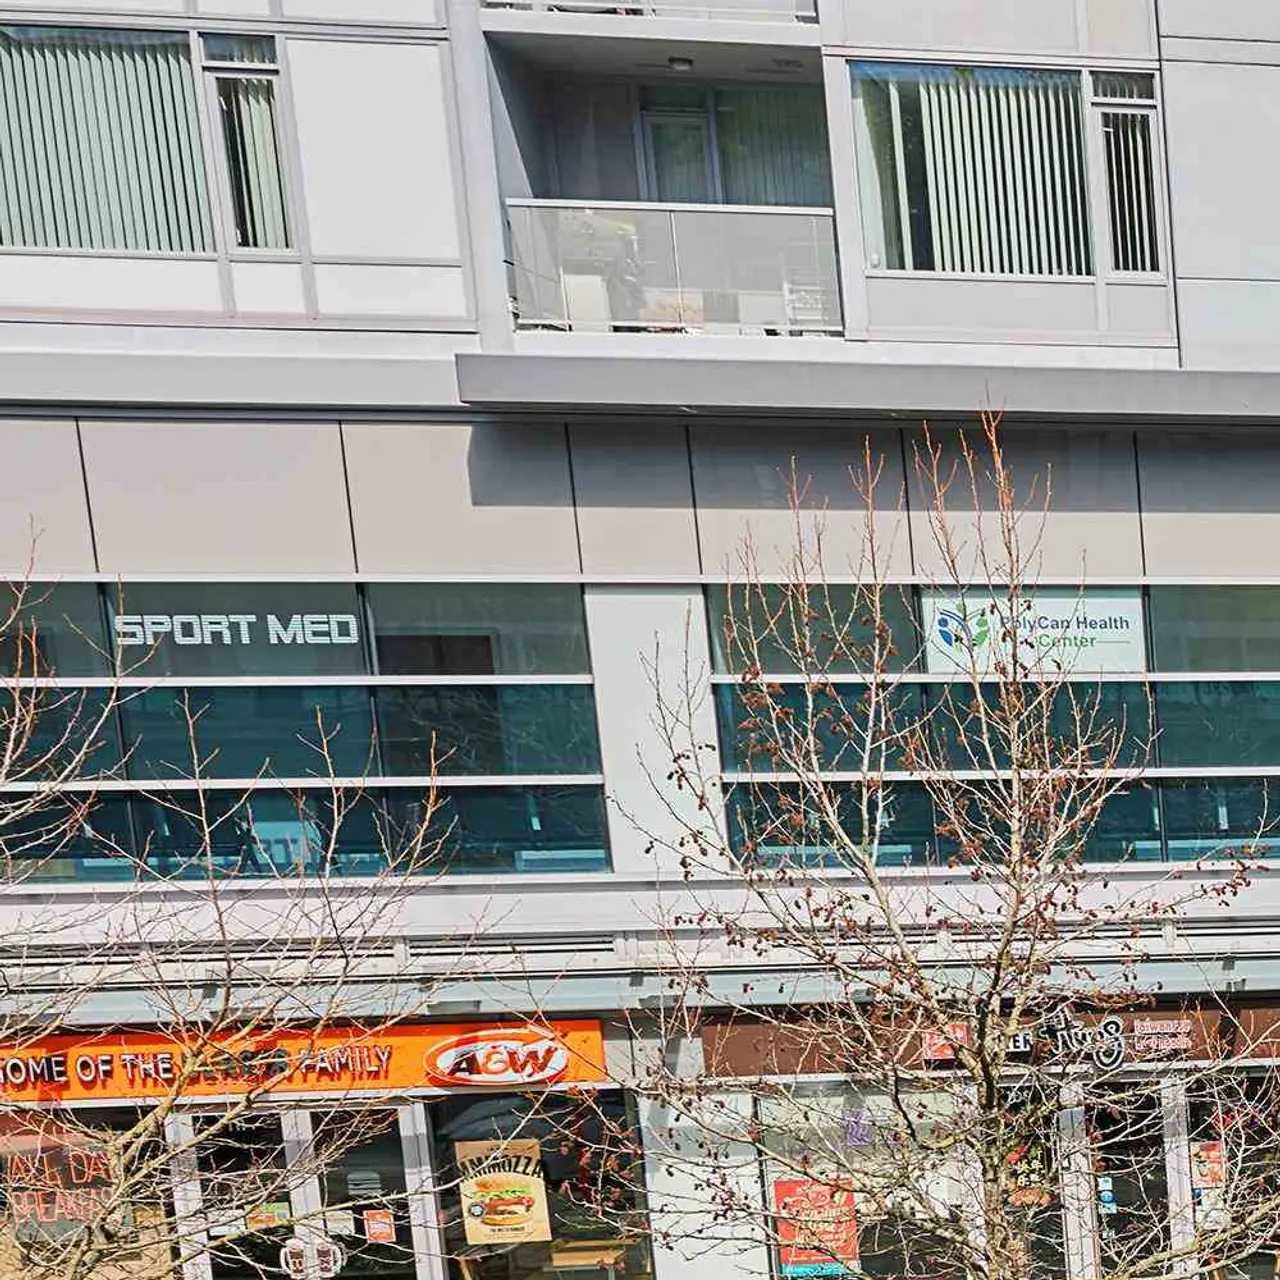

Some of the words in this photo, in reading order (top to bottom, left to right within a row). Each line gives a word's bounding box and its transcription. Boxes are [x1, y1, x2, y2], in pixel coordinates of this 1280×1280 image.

[115, 614, 257, 645] SPORT
[267, 614, 359, 645] MED
[1076, 615, 1130, 630] Health
[1039, 634, 1097, 648] Center
[0, 1056, 67, 1083] OME
[76, 1055, 112, 1082] OF
[120, 1053, 173, 1079] THE
[300, 1045, 391, 1073] FAMILY
[449, 1046, 557, 1077] A&W
